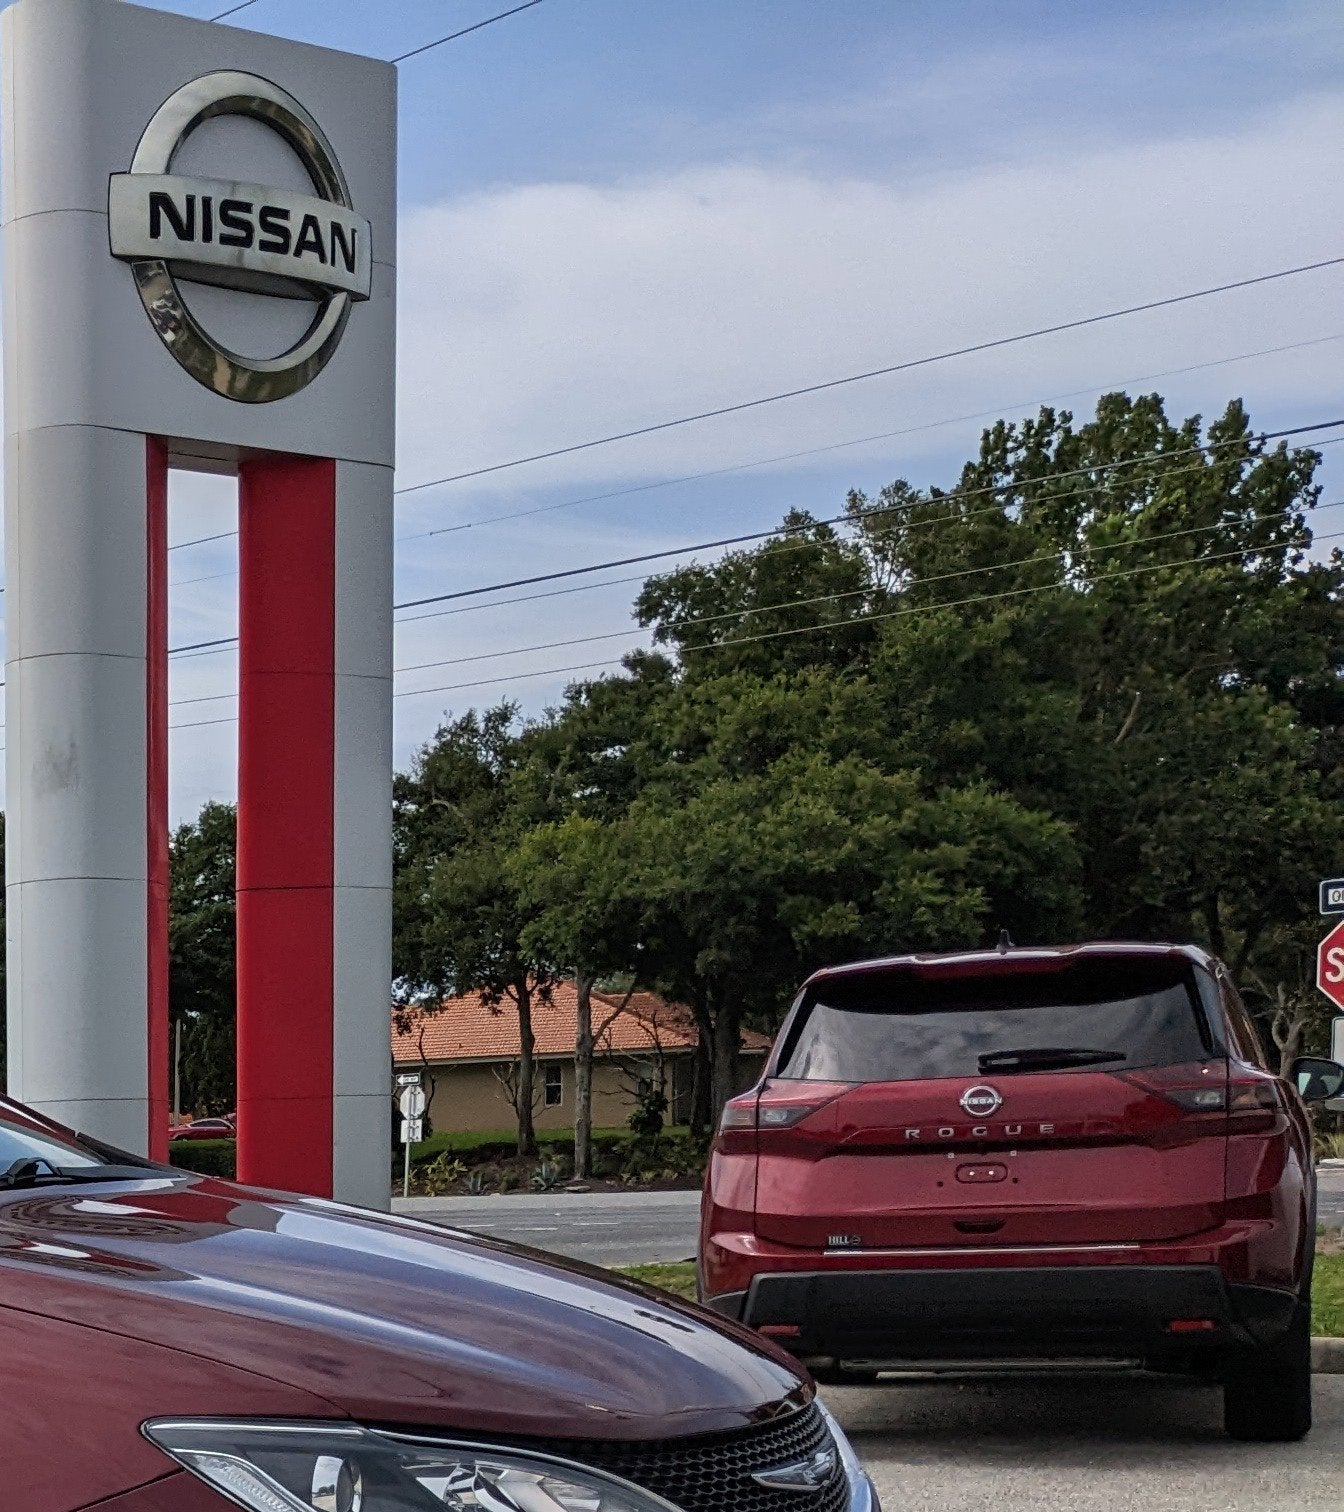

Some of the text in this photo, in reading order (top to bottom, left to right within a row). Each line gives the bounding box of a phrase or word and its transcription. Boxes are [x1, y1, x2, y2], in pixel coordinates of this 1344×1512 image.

[149, 191, 357, 274] NISSAN
[959, 1096, 1003, 1105] NISSAN
[905, 1123, 1055, 1139] ROGUE
